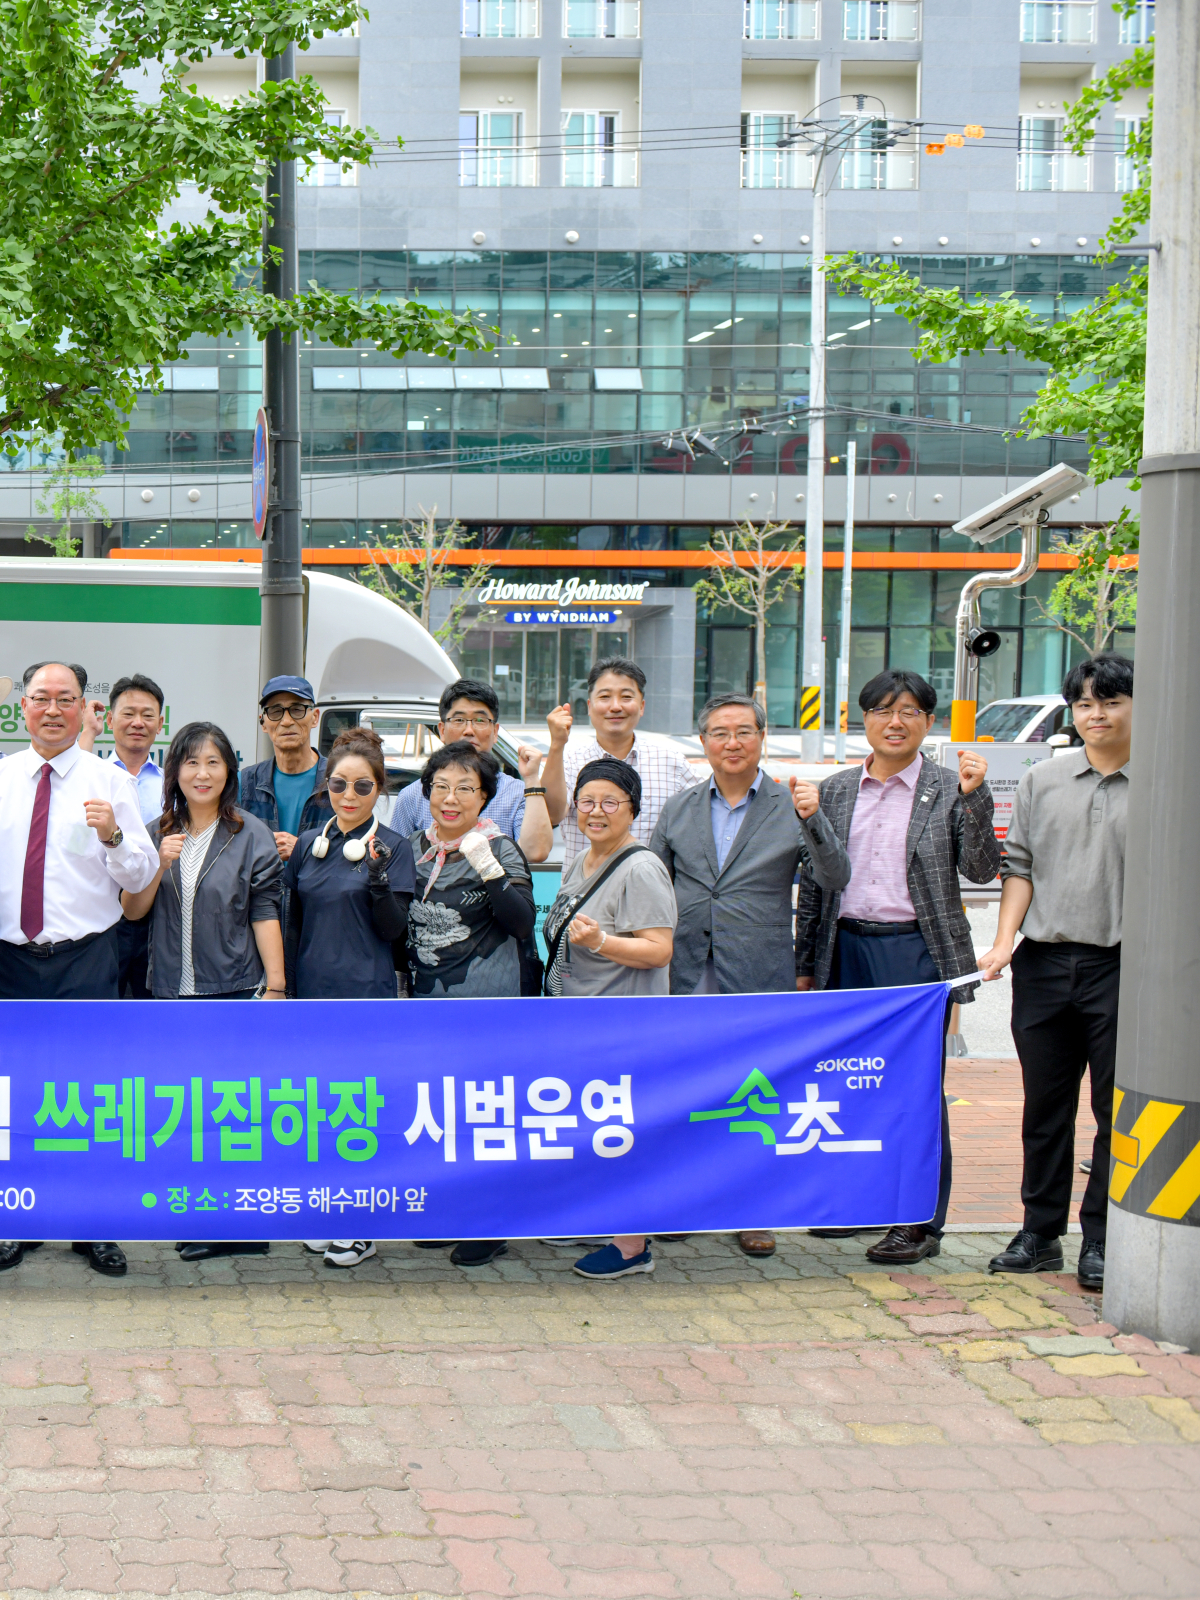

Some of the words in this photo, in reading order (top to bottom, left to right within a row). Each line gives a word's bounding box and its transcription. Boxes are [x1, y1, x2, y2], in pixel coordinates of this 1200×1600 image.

[478, 578, 563, 603] Howard
[559, 577, 645, 606] Johnson
[513, 613, 532, 623] BY
[537, 612, 610, 623] WYNDHAM
[813, 1056, 886, 1073] SOKCHO
[845, 1075, 884, 1090] CITY
[33, 1076, 384, 1163] 쓰레기집하장
[403, 1074, 635, 1163] 시범운영
[689, 1067, 883, 1156] 속초
[234, 1186, 304, 1214] 조양동
[307, 1186, 400, 1214] 해수피아
[404, 1186, 428, 1213] 앞
